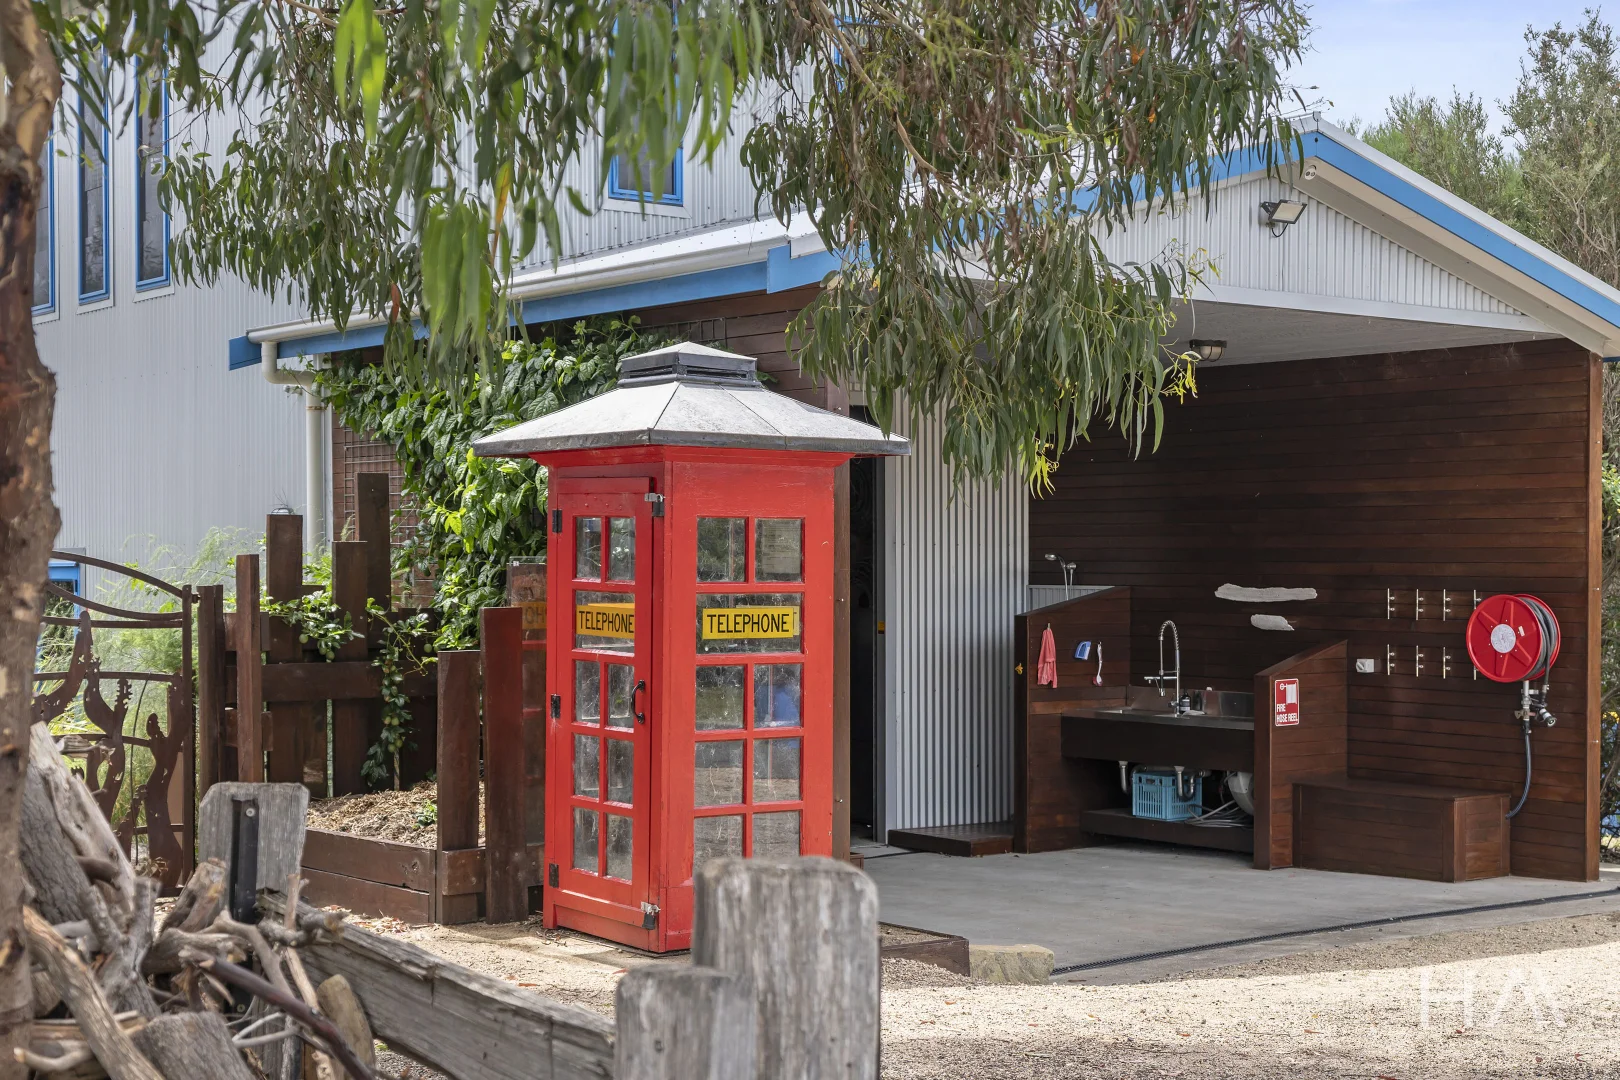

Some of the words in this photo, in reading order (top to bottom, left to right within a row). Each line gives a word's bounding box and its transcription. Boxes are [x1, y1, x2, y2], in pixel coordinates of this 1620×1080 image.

[578, 610, 635, 634] TELEPHONE
[706, 613, 790, 634] TELEPHONE
[1276, 703, 1286, 712] FIRE
[1276, 713, 1288, 723] HOSE
[1288, 712, 1298, 722] REEL
